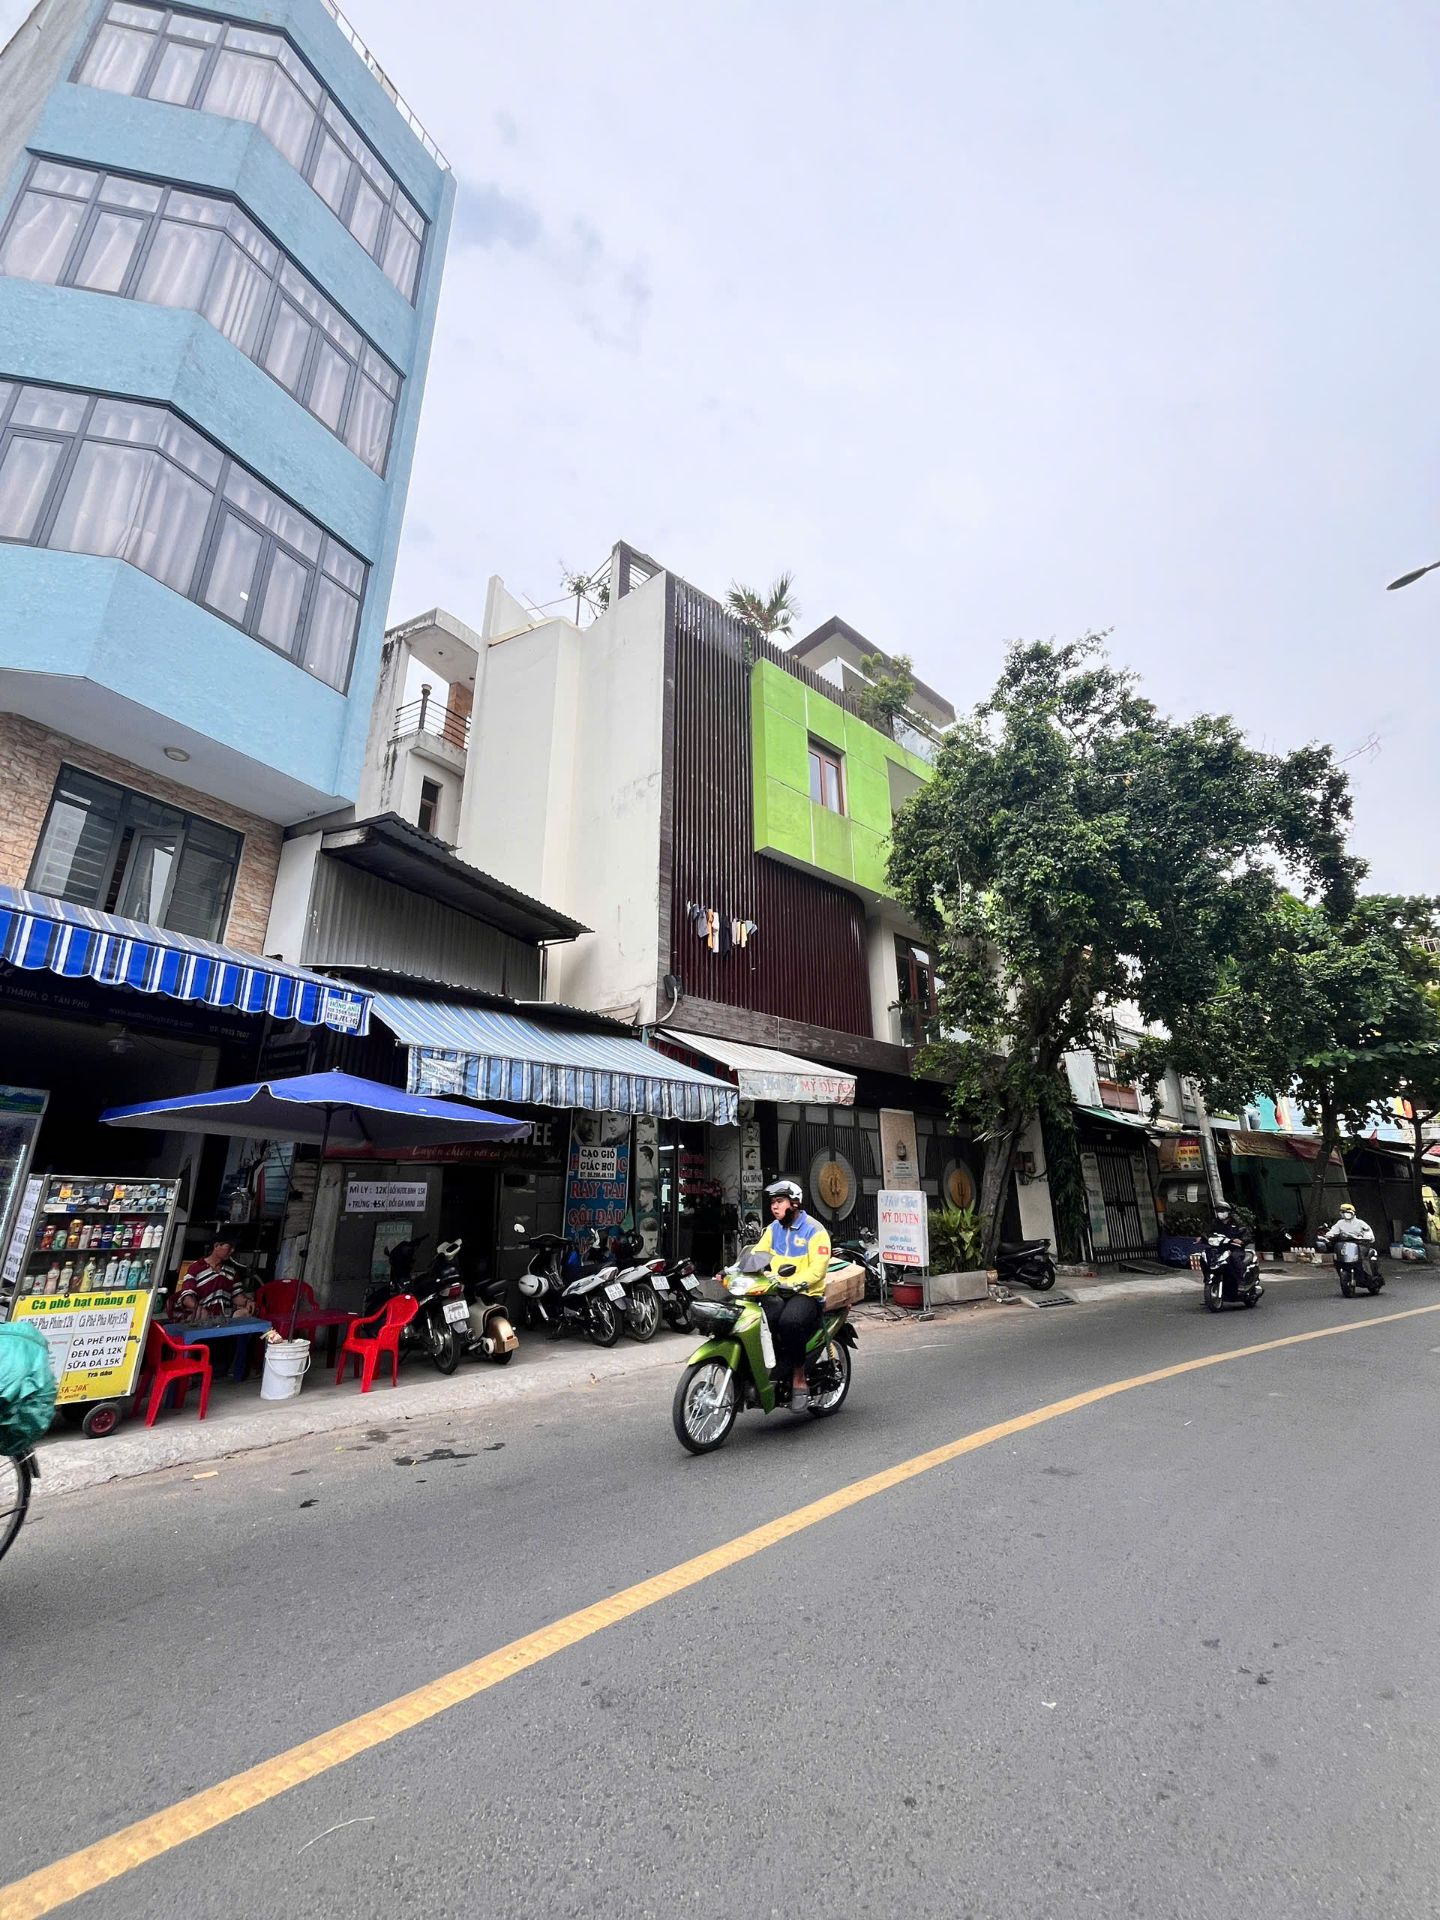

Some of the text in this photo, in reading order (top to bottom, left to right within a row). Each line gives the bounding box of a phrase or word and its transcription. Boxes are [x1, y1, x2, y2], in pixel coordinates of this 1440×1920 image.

[581, 1148, 615, 1160] CẠO GIÓ
[580, 1160, 600, 1171] GIÁC
[601, 1161, 615, 1171] HƠI
[375, 1186, 387, 1194] 12K
[602, 1181, 626, 1199] TAI
[49, 1296, 71, 1310] phê
[73, 1297, 91, 1309] hạt
[94, 1295, 124, 1307] mang
[126, 1294, 137, 1304] đi
[73, 1335, 85, 1347] CÀ
[87, 1334, 104, 1345] PHÊ
[106, 1334, 127, 1343] PHIN
[71, 1347, 123, 1358] ĐEN ĐÁ 12K
[67, 1358, 120, 1370] SỮA ĐÁ 15K
